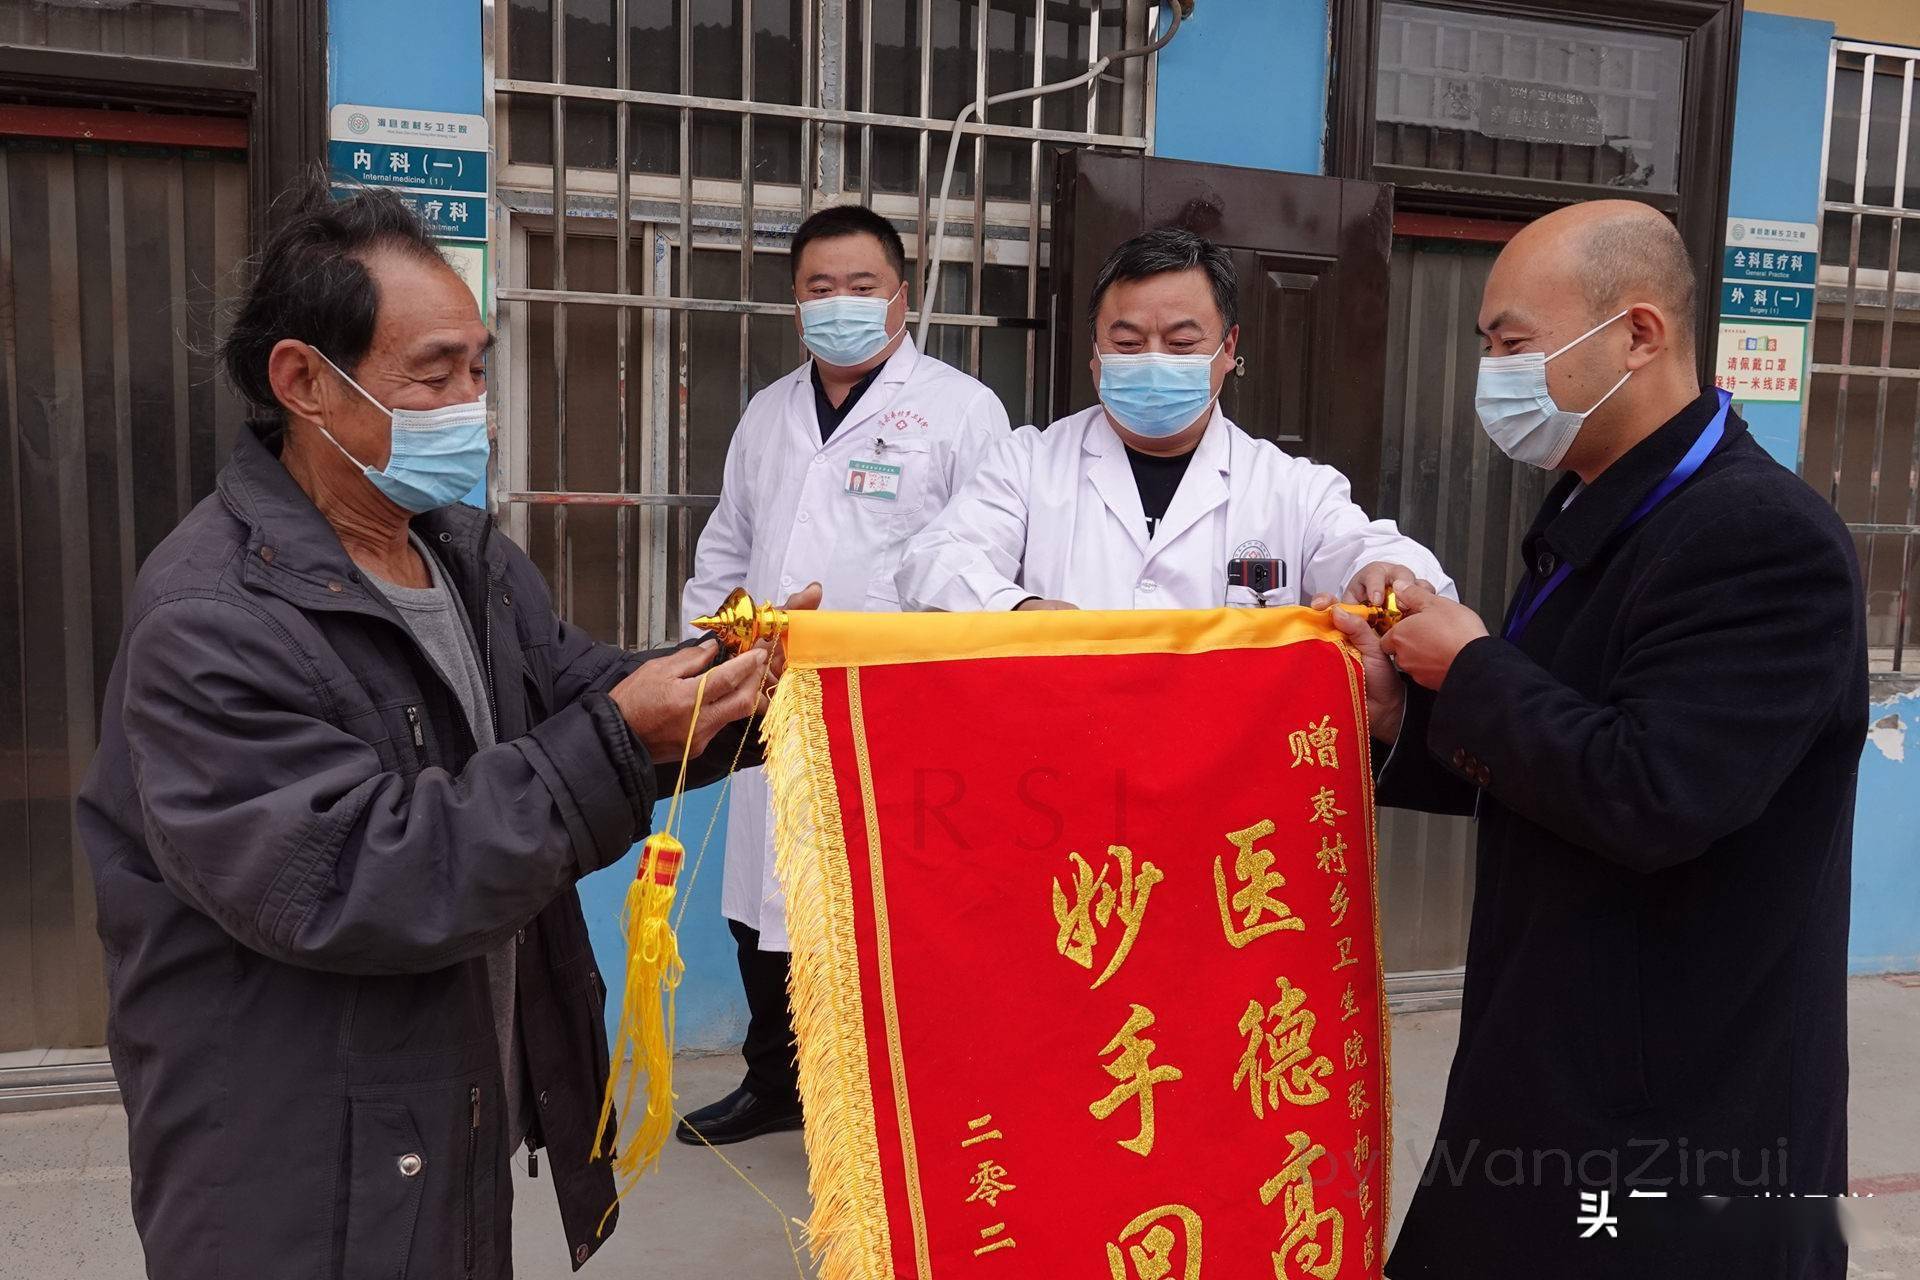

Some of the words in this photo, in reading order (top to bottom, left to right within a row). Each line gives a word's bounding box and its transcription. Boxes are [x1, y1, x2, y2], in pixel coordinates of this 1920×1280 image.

[363, 173, 391, 181] Internal
[393, 175, 425, 184] medicine
[1734, 251, 1803, 271] 全科医疗科
[1745, 269, 1767, 277] General
[1749, 307, 1768, 315] Surgery
[1728, 357, 1787, 372] 请佩戴口罩
[1715, 375, 1798, 391] 保持一米线距离
[961, 1114, 1017, 1256] 二零二
